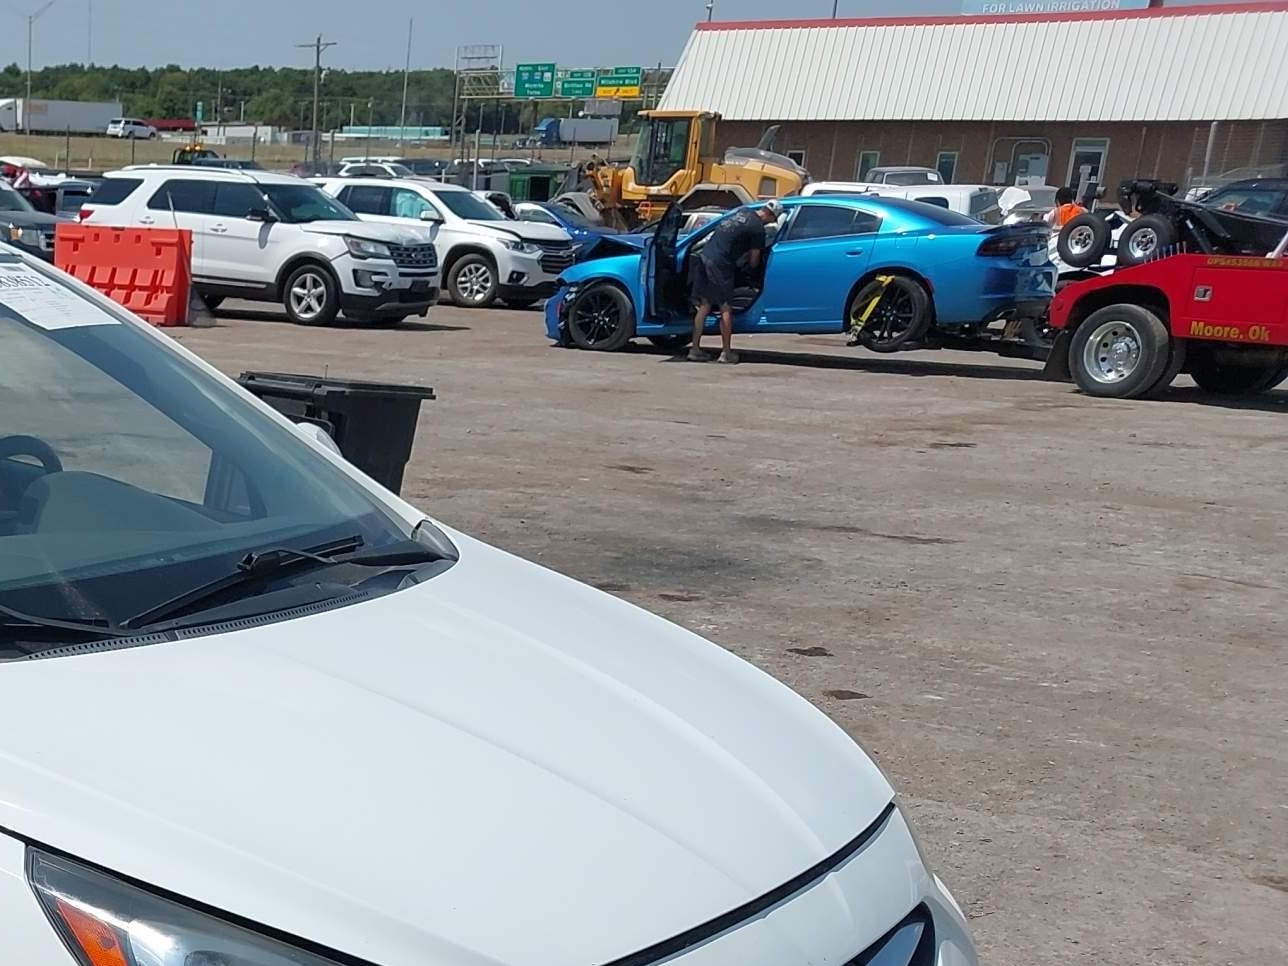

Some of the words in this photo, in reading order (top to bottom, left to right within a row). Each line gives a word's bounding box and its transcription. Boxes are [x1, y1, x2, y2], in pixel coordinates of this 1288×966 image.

[982, 3, 1006, 14] FOR
[1008, 2, 1044, 13] LAWN
[1046, 0, 1120, 11] IRRIGATION
[1248, 325, 1272, 342] Ok
